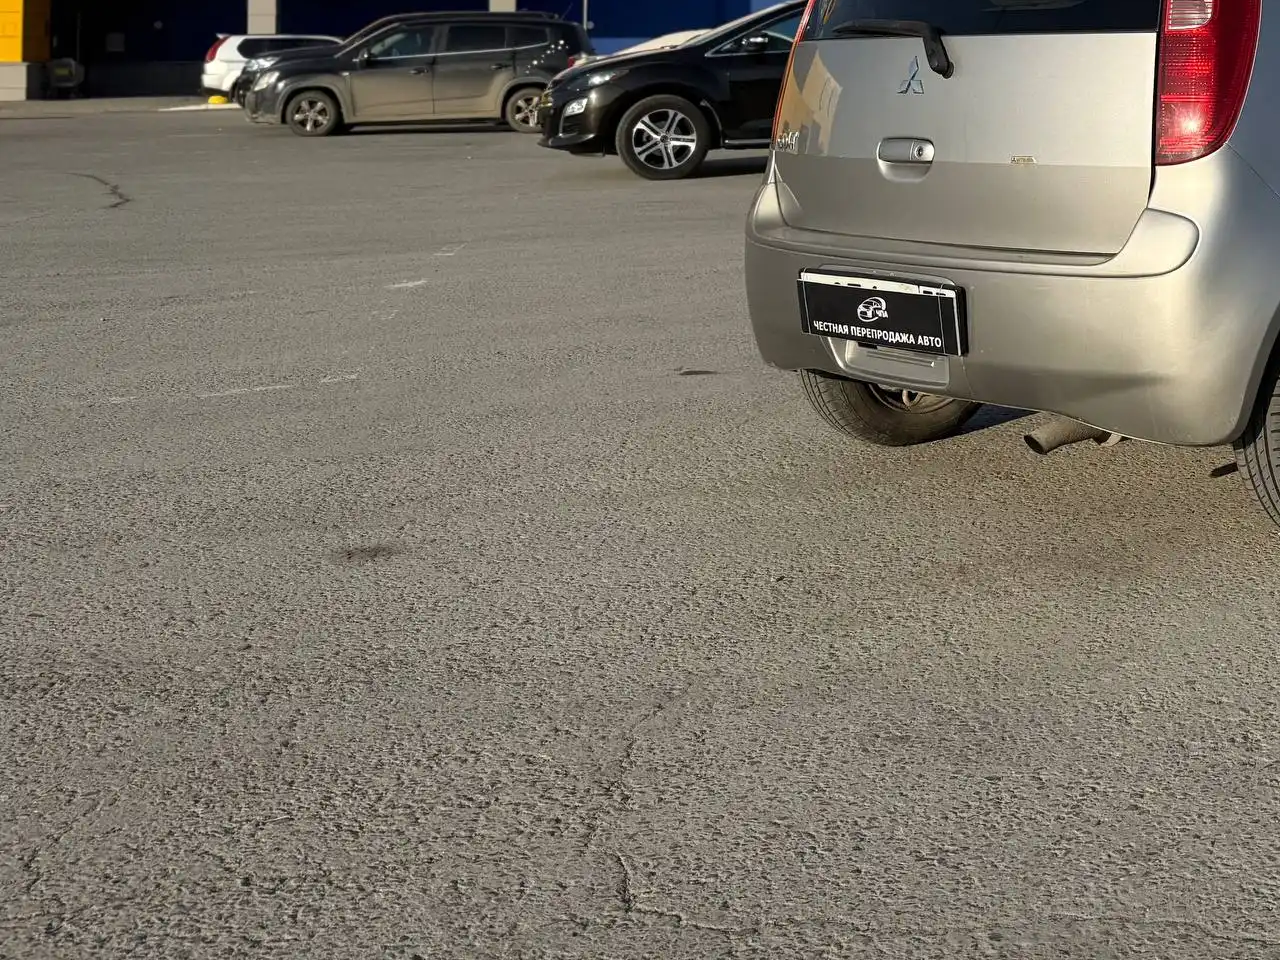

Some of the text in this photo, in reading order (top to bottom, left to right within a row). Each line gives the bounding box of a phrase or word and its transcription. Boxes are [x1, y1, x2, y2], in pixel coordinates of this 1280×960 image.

[813, 319, 942, 348] ЧЕСТНАЯ ПЕРЕПРОДАЖА АВТО
